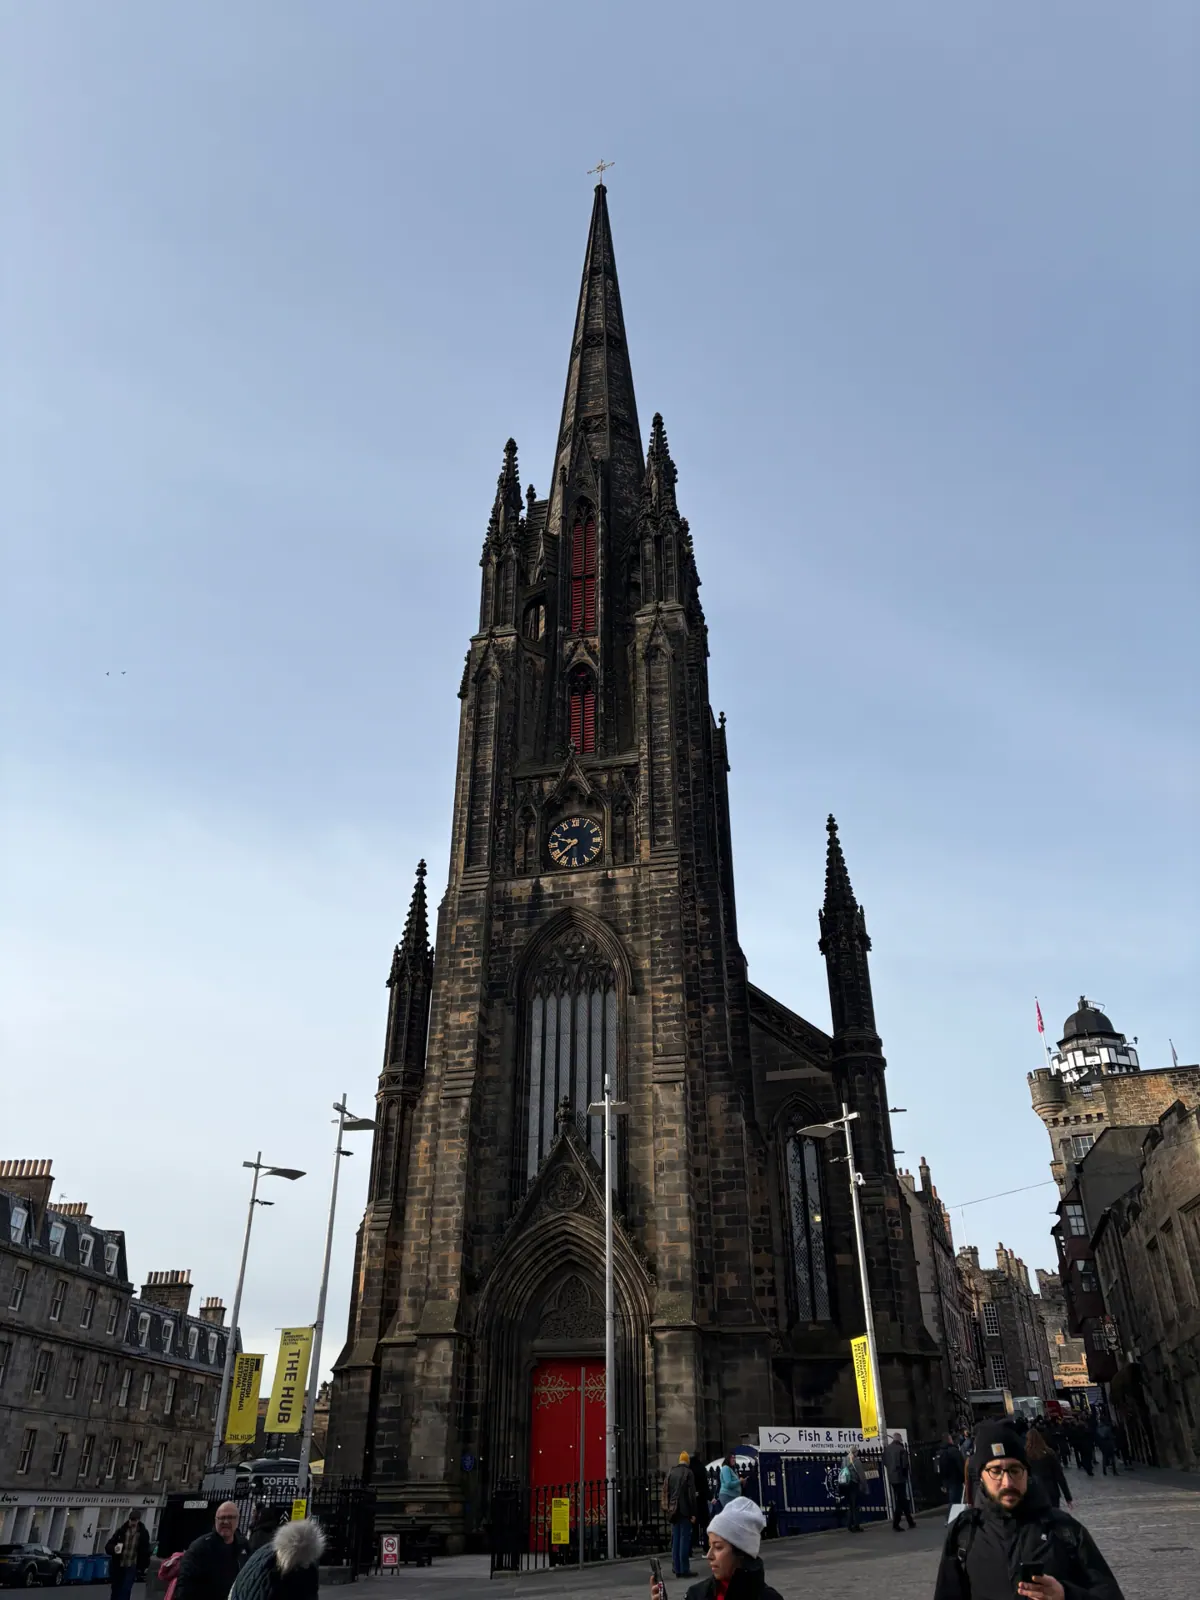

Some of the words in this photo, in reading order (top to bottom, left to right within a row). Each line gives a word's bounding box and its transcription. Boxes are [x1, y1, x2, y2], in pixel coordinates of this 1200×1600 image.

[236, 1357, 245, 1389] FESTIVAL
[244, 1358, 256, 1398] EDINBURGH
[284, 1349, 301, 1382] THE
[238, 1357, 250, 1412] INTERNATIONAL
[277, 1386, 295, 1424] HUB
[798, 1430, 821, 1442] Fish
[825, 1430, 833, 1442] &
[262, 1476, 299, 1486] COFFEE
